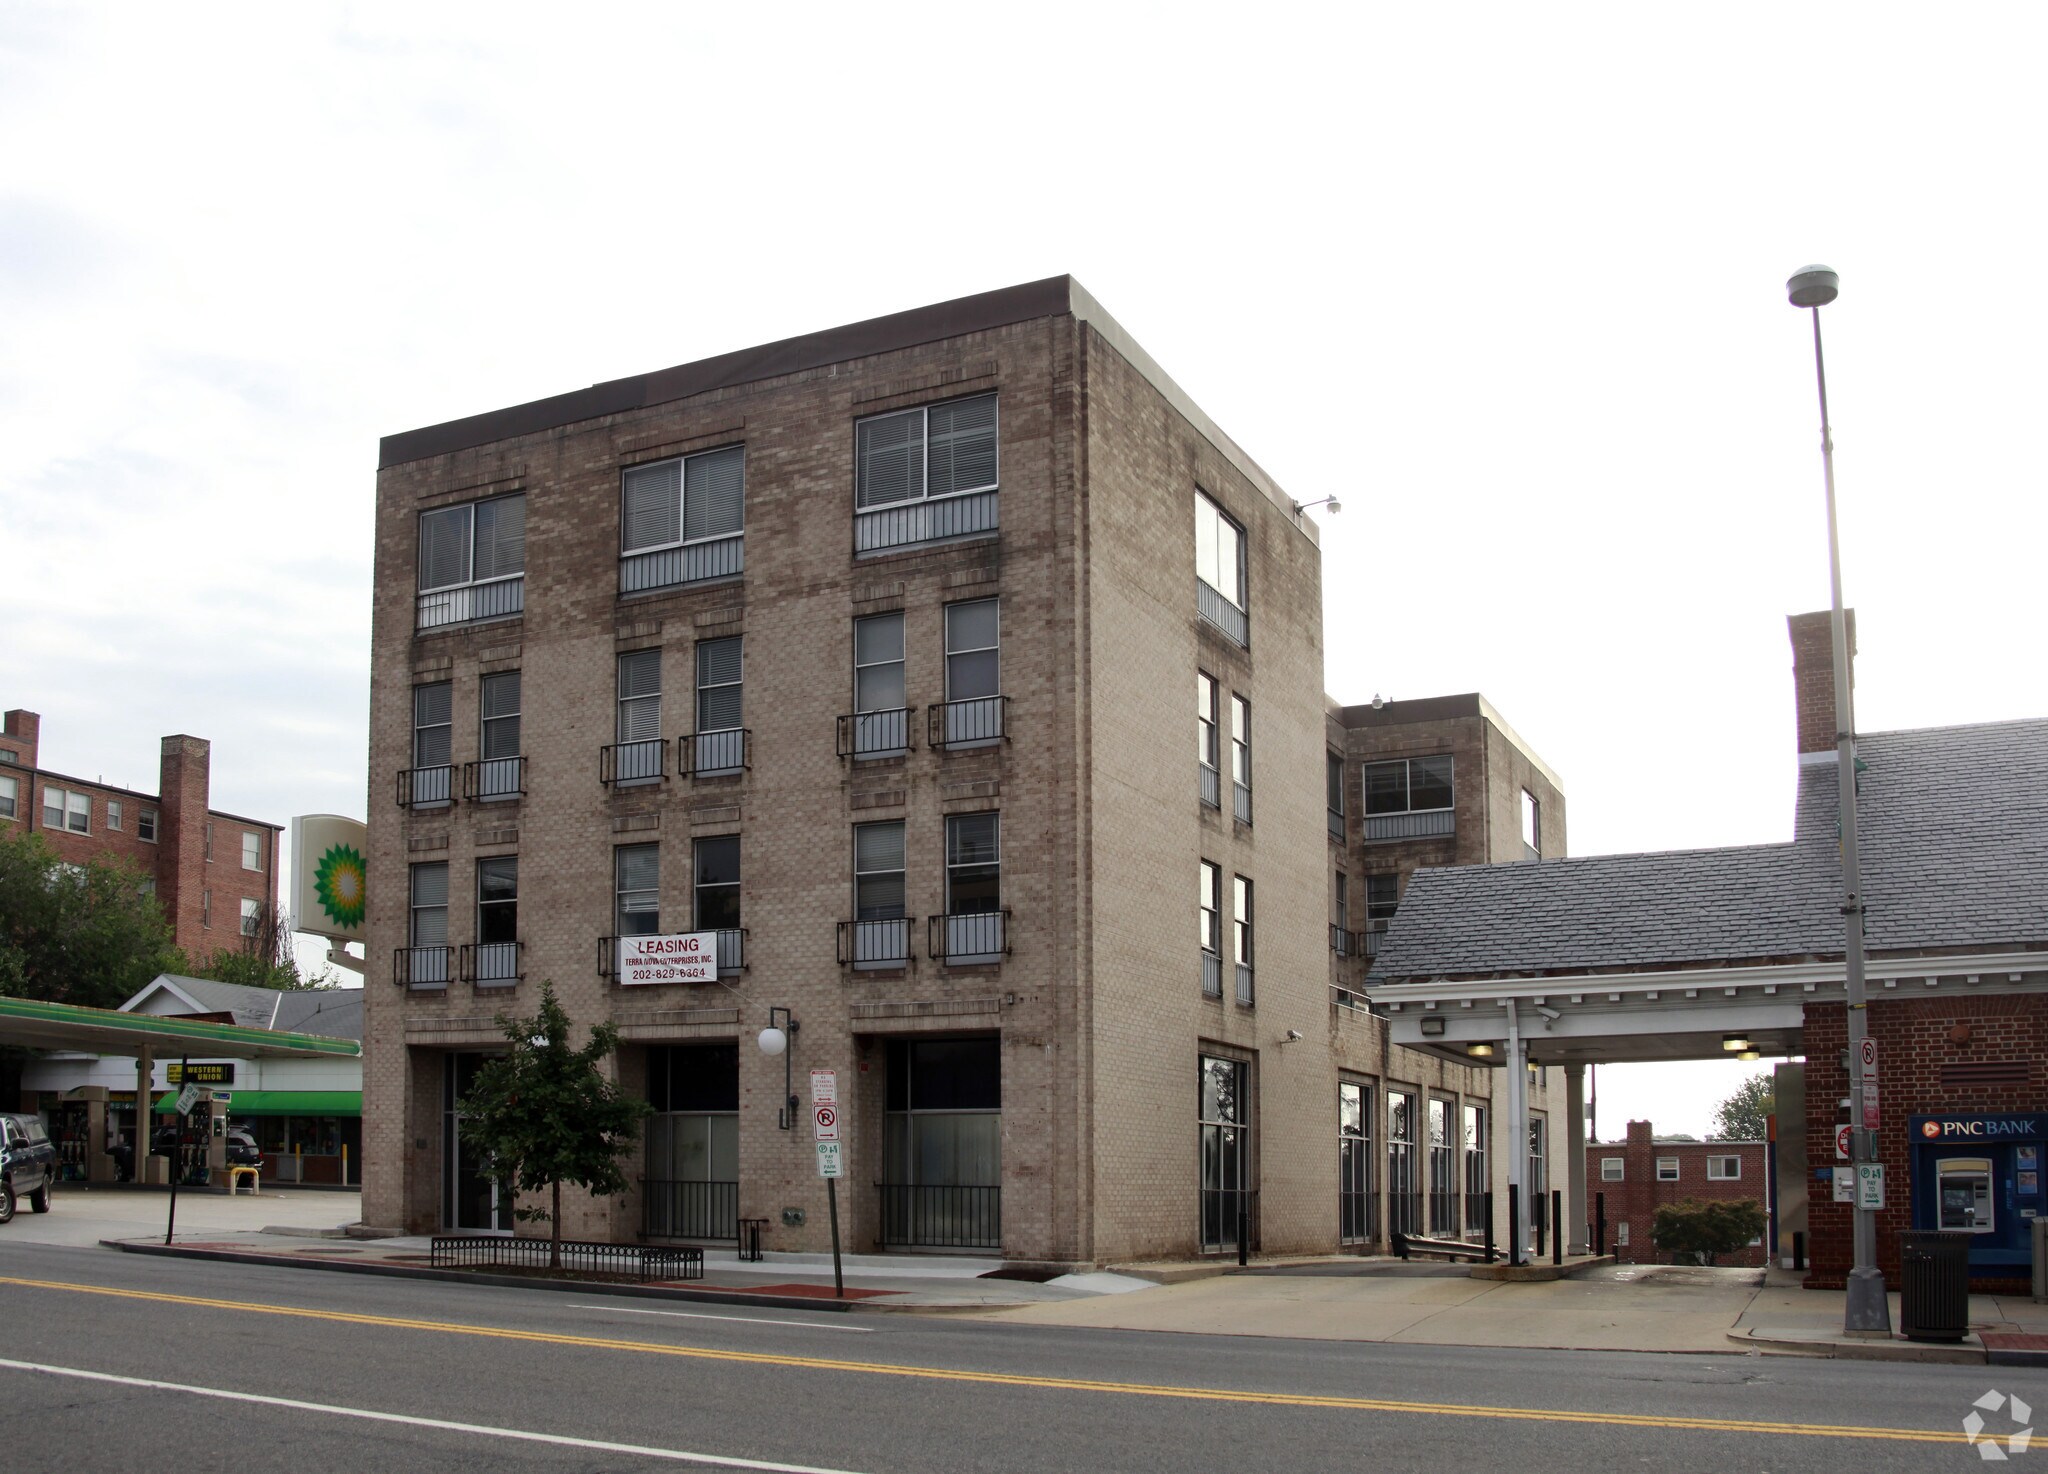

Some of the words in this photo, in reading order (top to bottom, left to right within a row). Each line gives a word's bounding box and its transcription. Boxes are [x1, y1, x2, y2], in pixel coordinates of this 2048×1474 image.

[638, 939, 699, 954] LEASING
[625, 958, 643, 966] TERRA
[643, 957, 659, 965] NOVA
[701, 955, 714, 963] INC.
[632, 968, 706, 980] 202-829-6364
[1942, 1121, 1984, 1136] PNC
[1985, 1120, 2036, 1135] BANK
